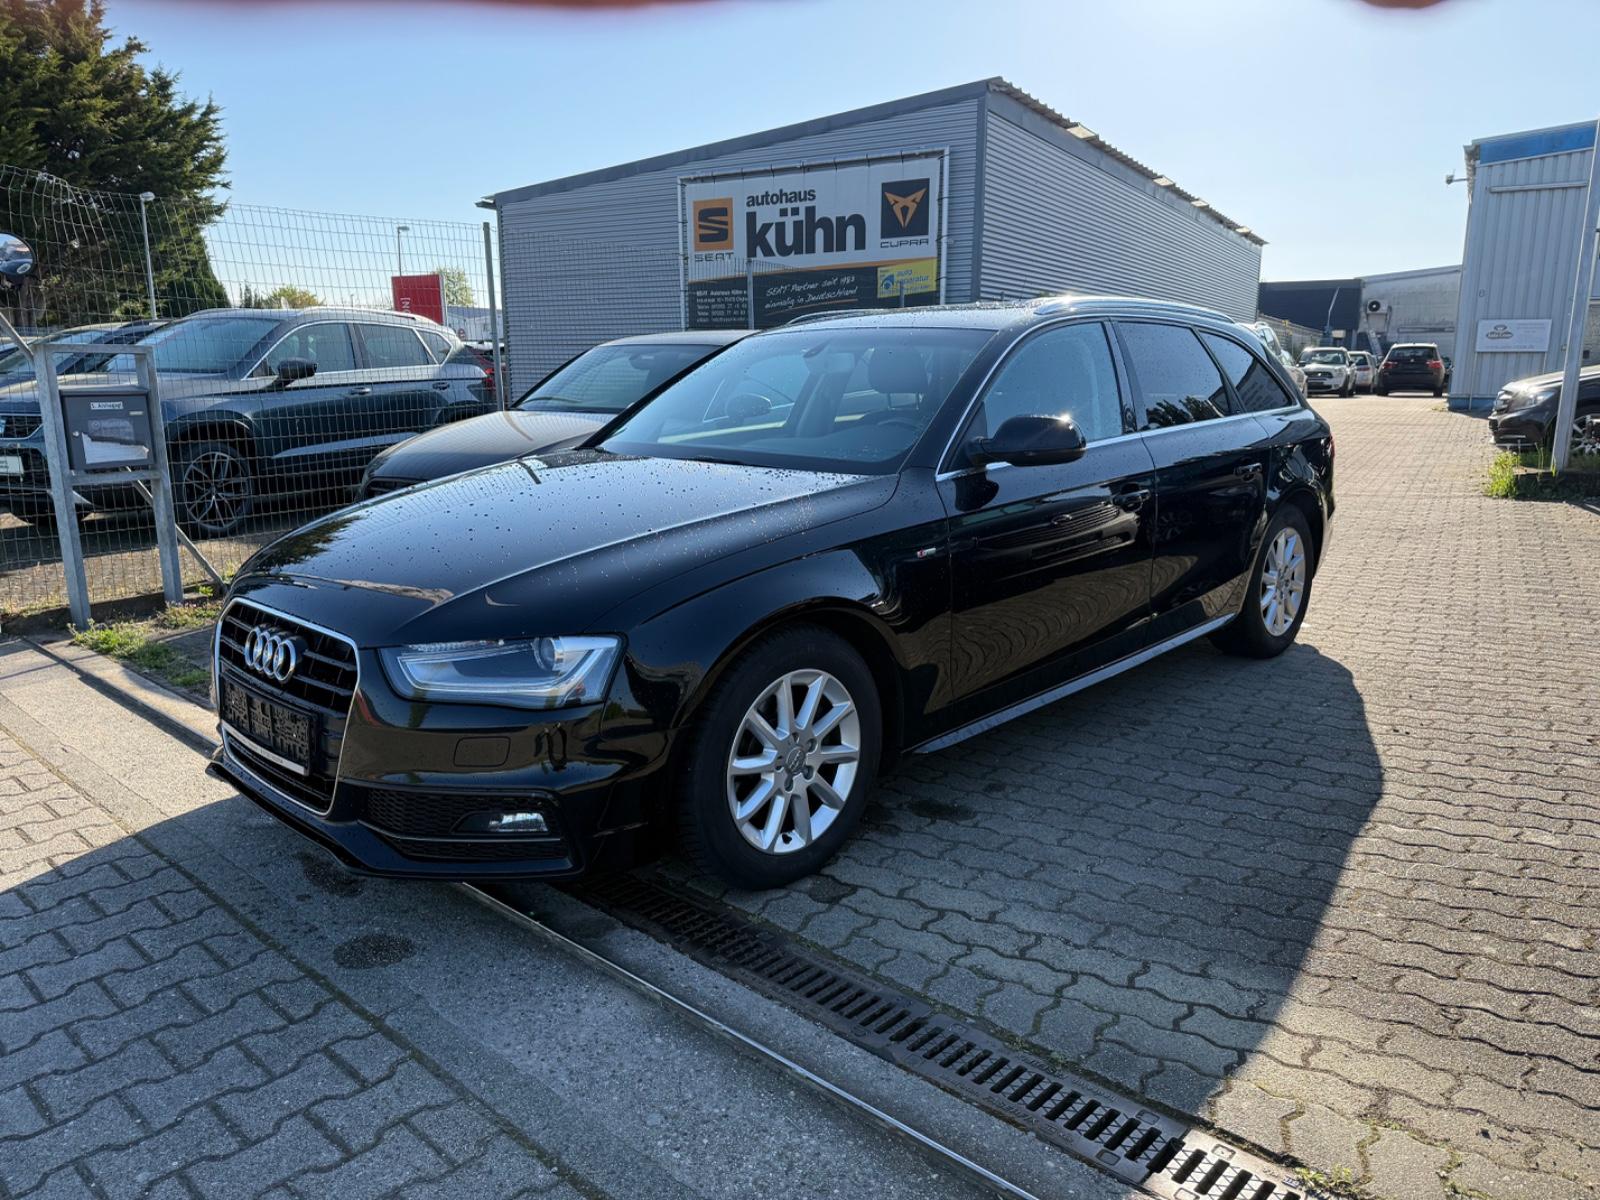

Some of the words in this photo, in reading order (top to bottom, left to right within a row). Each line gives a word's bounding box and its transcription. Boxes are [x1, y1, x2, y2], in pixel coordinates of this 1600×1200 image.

[746, 188, 816, 207] autohaus
[746, 205, 866, 258] kühn
[880, 238, 929, 249] CUPRA
[694, 251, 734, 262] SEAT
[766, 284, 790, 297] SEAT
